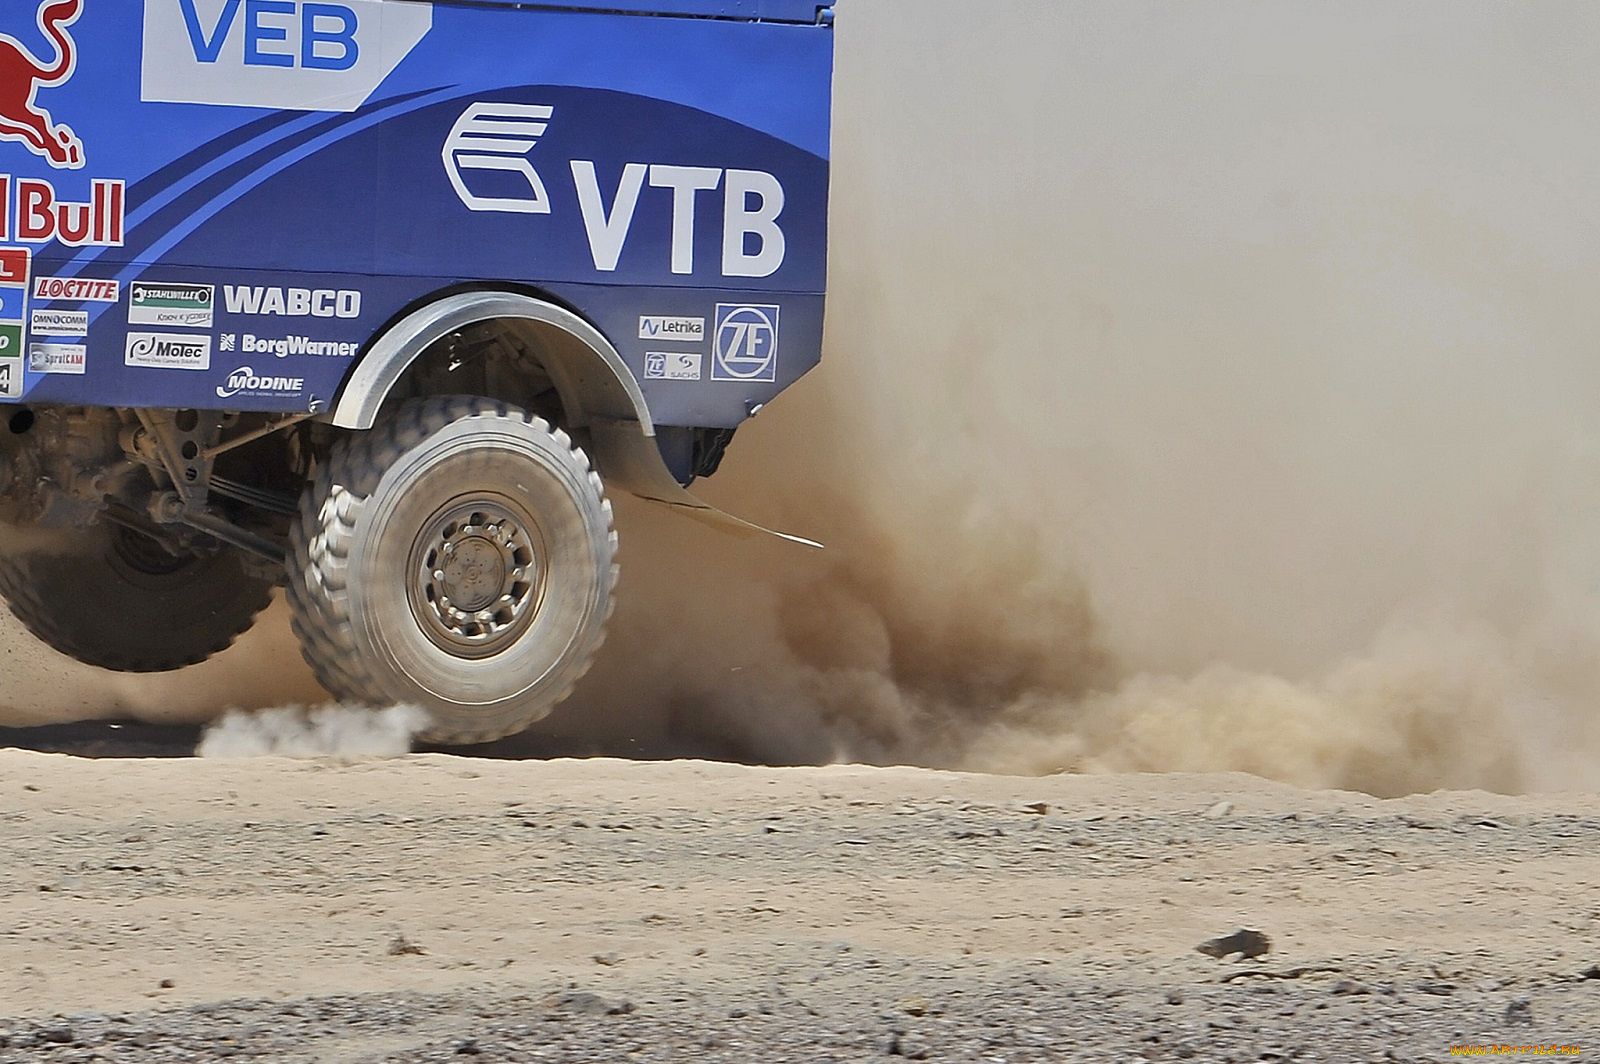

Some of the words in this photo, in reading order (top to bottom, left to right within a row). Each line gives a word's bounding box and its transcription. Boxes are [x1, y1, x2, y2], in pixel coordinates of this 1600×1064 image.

[569, 159, 786, 278] VTB
[36, 279, 117, 299] LOCTITE
[223, 285, 362, 319] WABCO
[662, 319, 702, 334] Letrika
[241, 334, 359, 358] BorgWarner
[722, 322, 772, 364] ZF
[227, 375, 305, 391] MODINE
